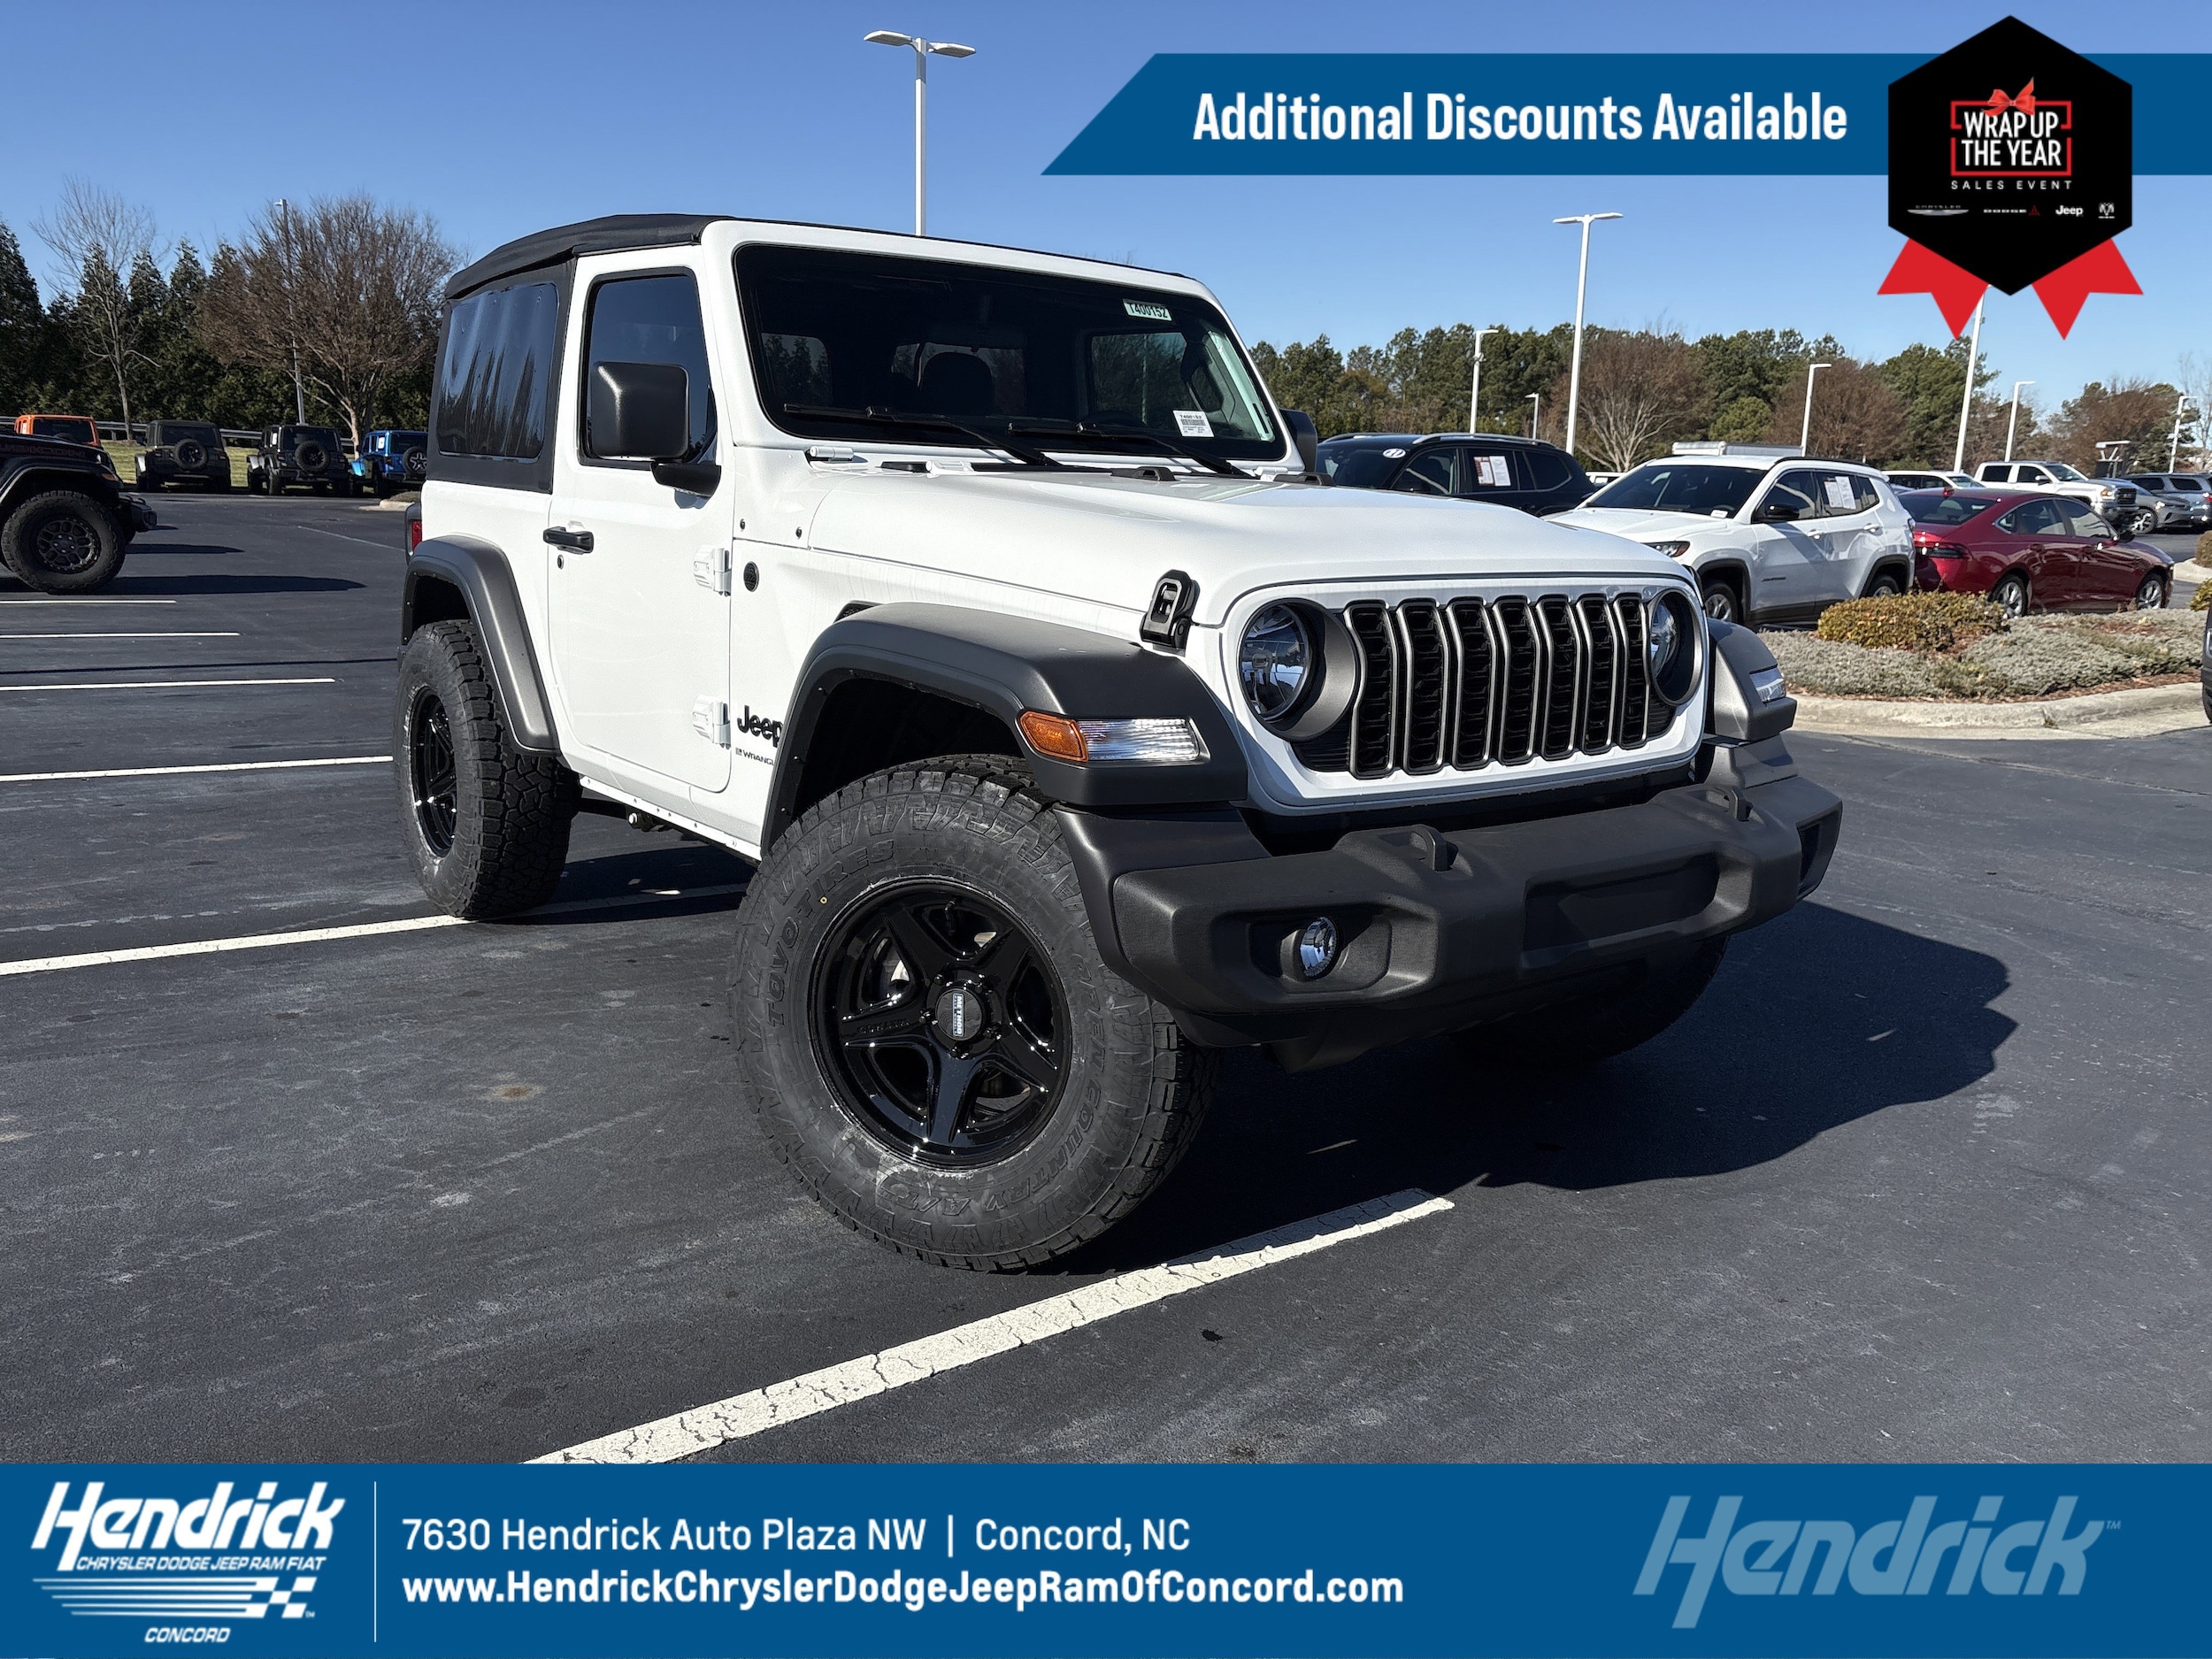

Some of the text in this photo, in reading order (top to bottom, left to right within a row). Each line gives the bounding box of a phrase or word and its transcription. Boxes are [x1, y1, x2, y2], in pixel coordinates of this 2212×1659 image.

[1130, 303, 1168, 319] T400152
[737, 705, 783, 748] Jeep
[766, 839, 895, 1027] TOYO TIRES
